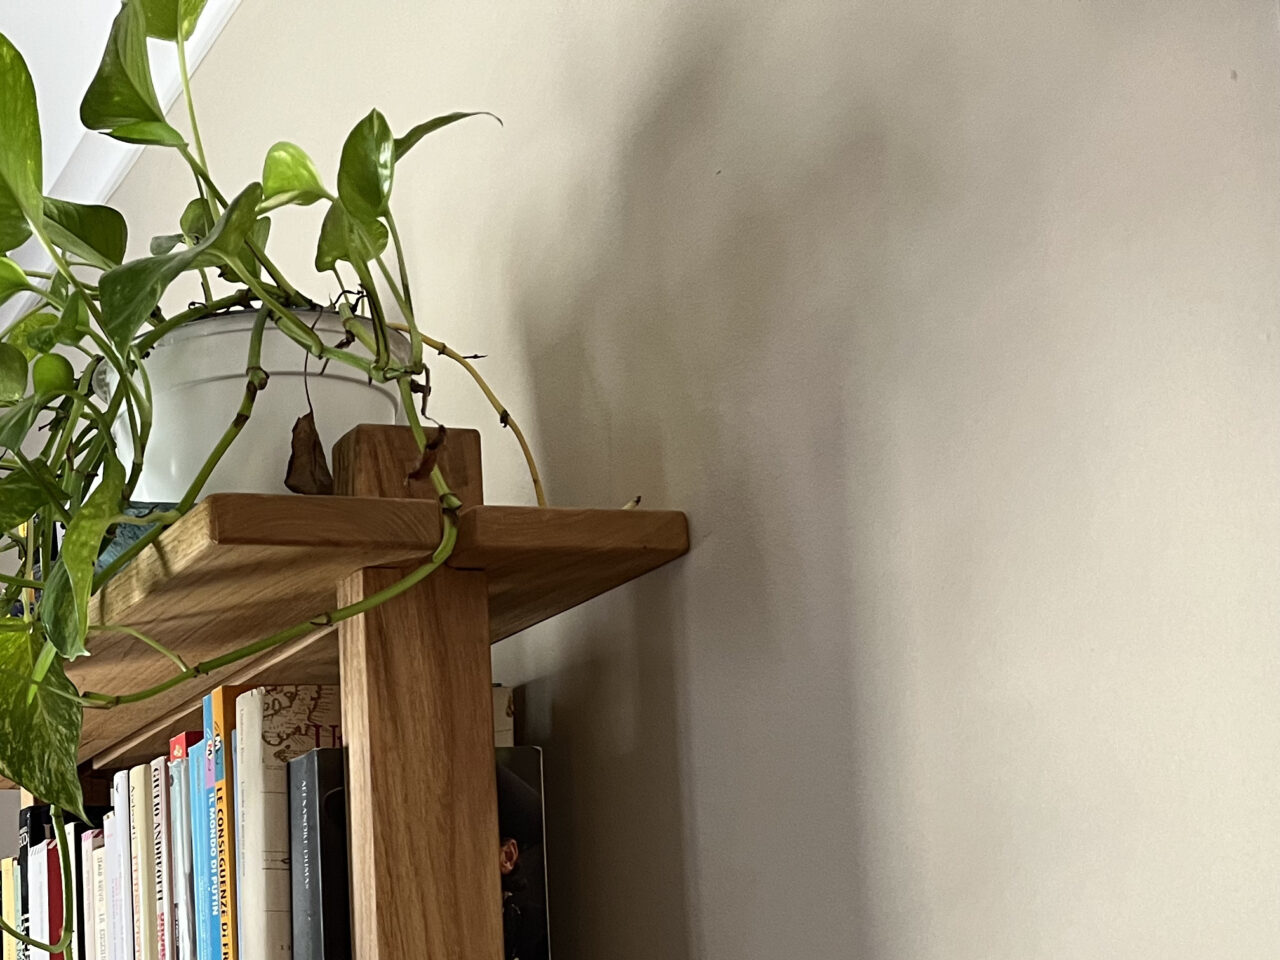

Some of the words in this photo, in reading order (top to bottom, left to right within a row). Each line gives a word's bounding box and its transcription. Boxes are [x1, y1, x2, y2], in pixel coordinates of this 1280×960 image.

[151, 767, 160, 817] GIULIO
[208, 792, 215, 804] IL
[216, 787, 224, 805] LE
[209, 808, 217, 861] MONDO
[154, 821, 163, 901] ANDREOTTI
[217, 808, 228, 917] CONSEGUENZE
[211, 876, 219, 916] PUTIN
[221, 921, 229, 937] DI
